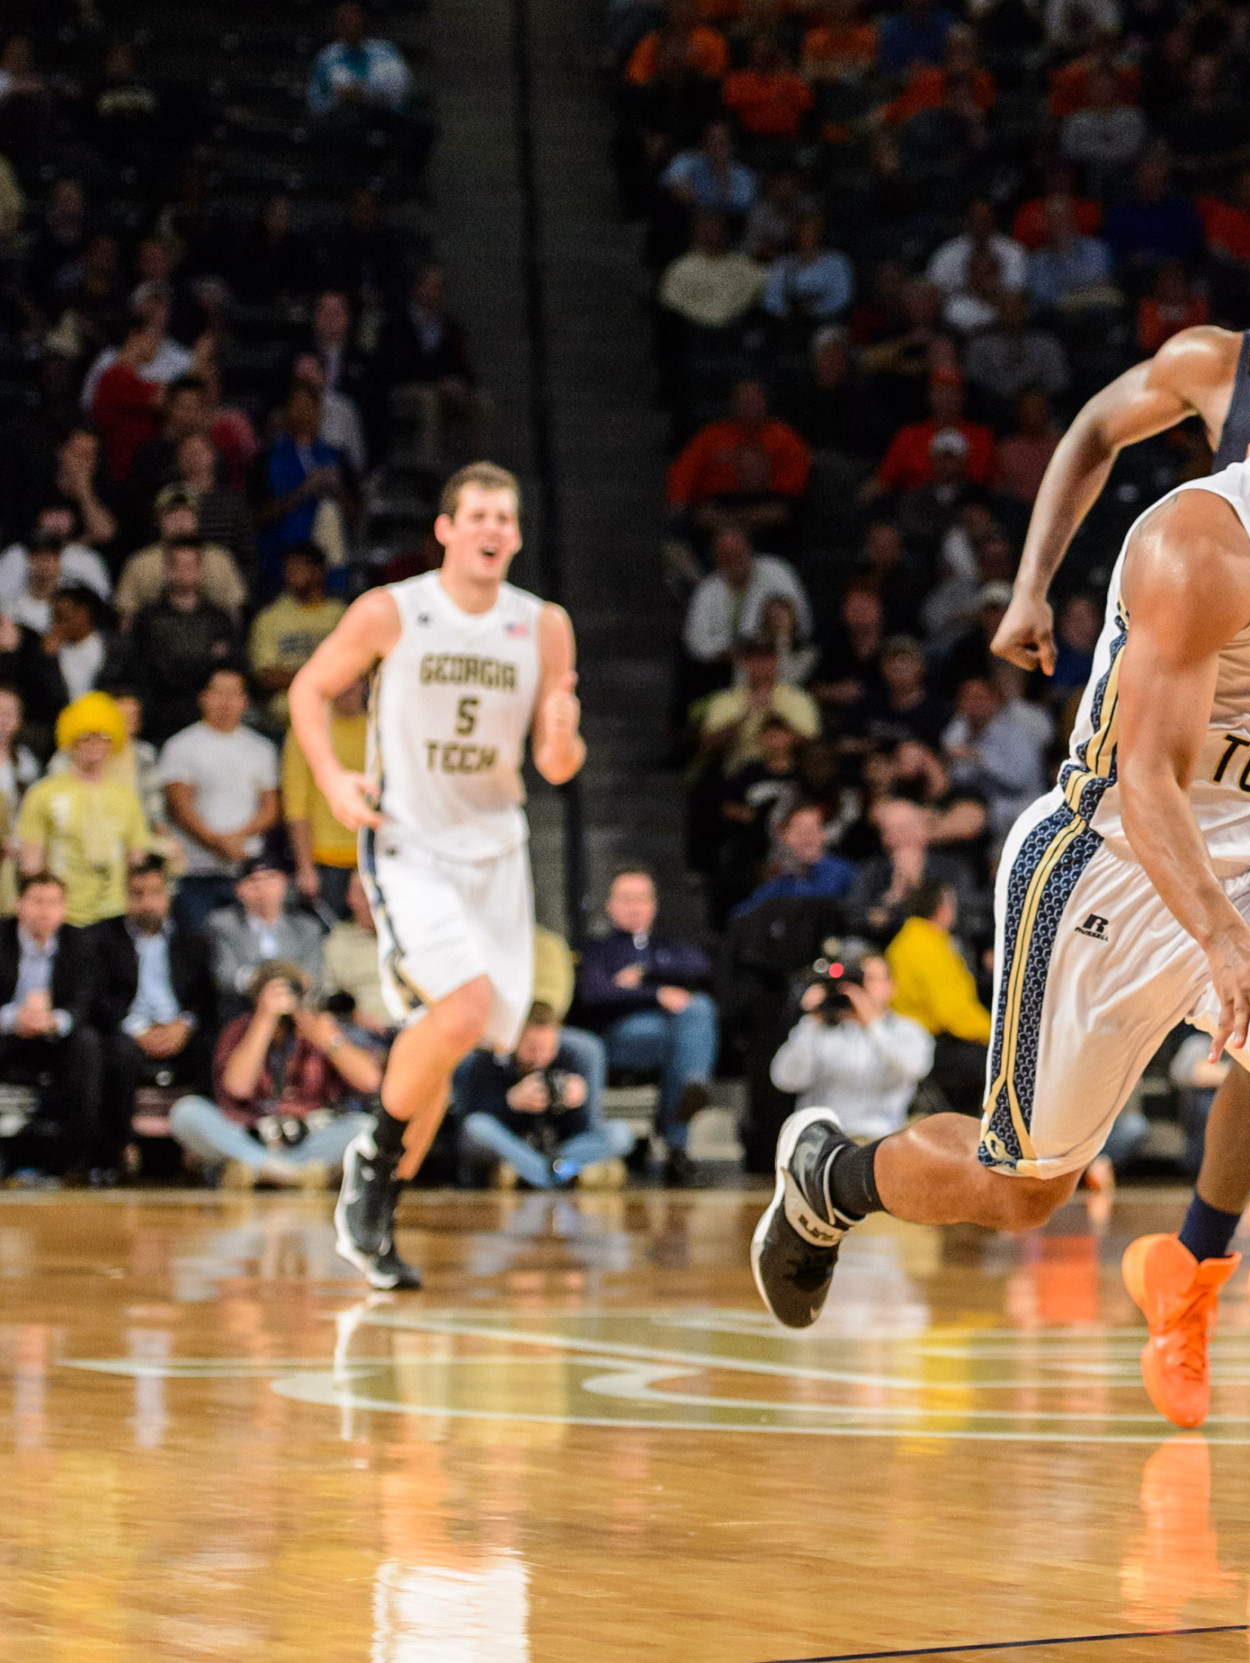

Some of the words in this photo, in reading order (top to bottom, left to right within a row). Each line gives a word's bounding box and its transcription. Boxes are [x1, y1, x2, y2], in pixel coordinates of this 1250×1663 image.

[419, 653, 518, 691] GEORGIA
[455, 696, 481, 737] 5
[424, 739, 499, 773] TECH
